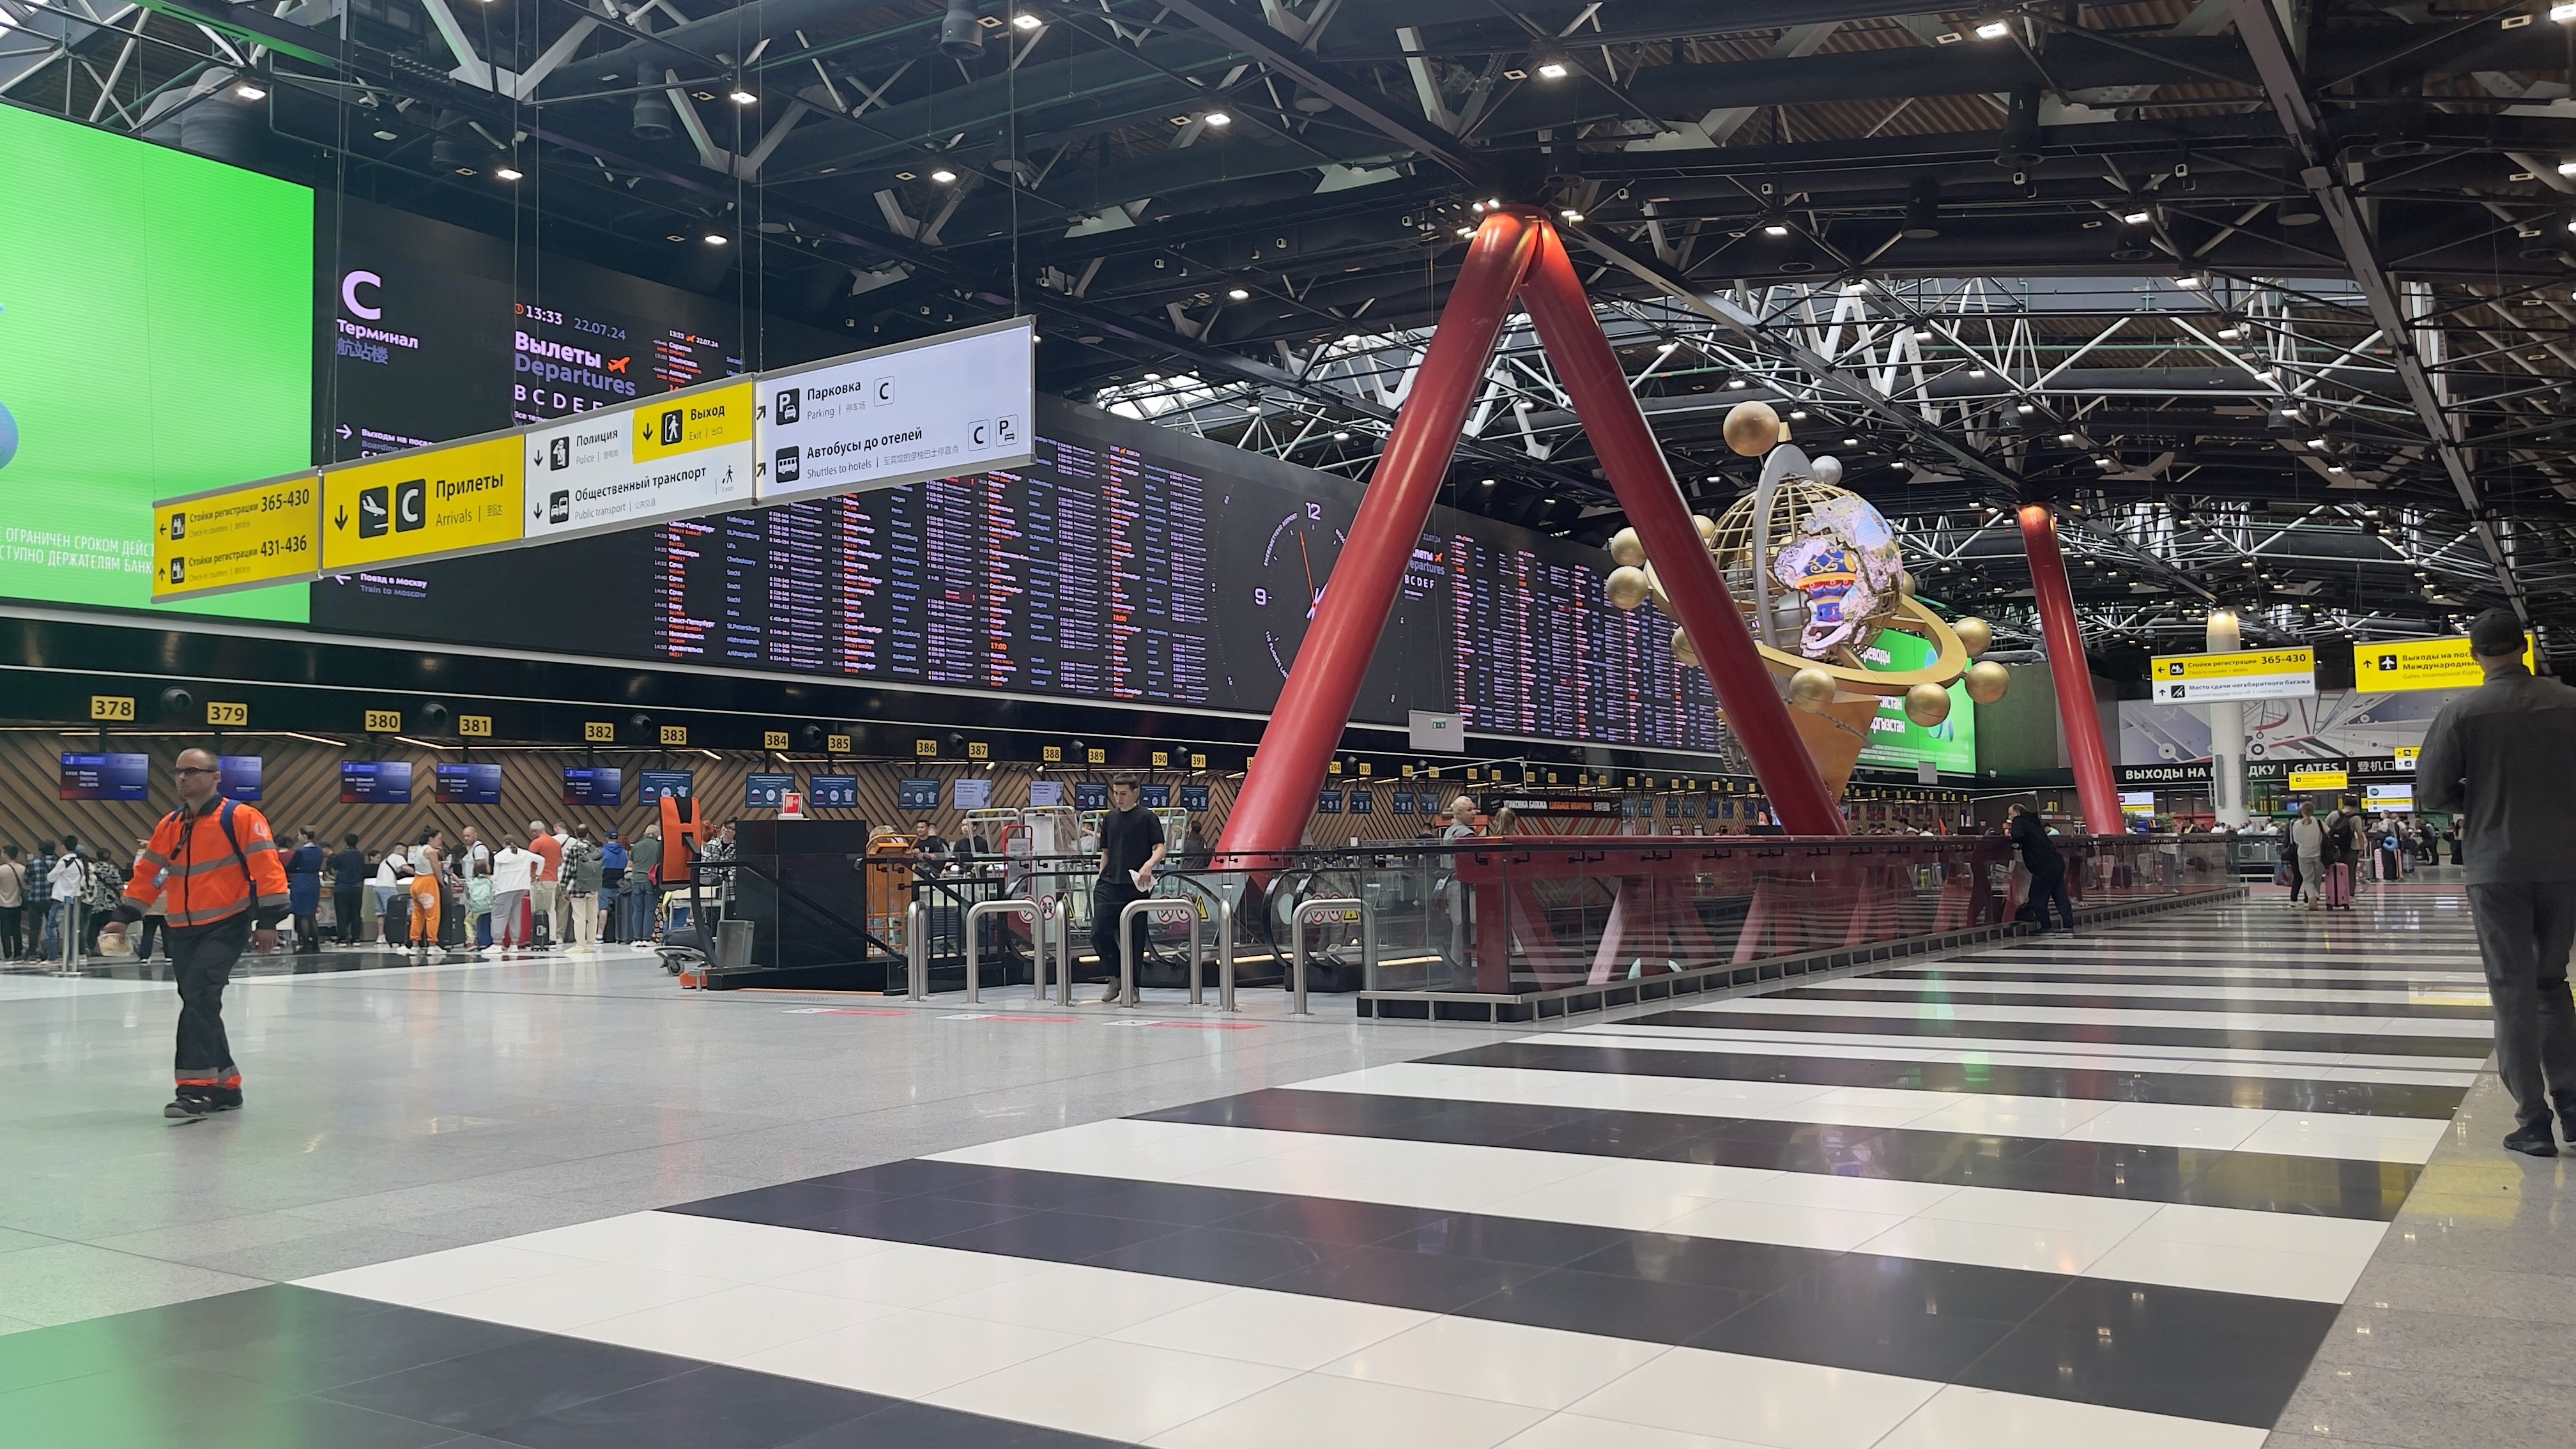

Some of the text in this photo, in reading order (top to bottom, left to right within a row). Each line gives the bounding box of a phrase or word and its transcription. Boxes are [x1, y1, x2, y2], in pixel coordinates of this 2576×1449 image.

[342, 271, 381, 319] C
[526, 305, 626, 341] 13:33 22.07.24
[336, 319, 418, 349] Терминал
[337, 337, 388, 365] 航站楼
[515, 331, 602, 369] Вылеты
[515, 353, 636, 397] Departures
[514, 384, 526, 401] B
[533, 389, 546, 406] C
[553, 392, 567, 409] D
[574, 396, 584, 414] E
[807, 381, 889, 402] Парковка C
[691, 405, 725, 421] Выход
[807, 406, 835, 420] Parking
[361, 429, 395, 441] Выходы
[576, 429, 618, 447] Полиция
[689, 431, 702, 441] Exit
[711, 426, 723, 436] 出口
[807, 440, 861, 460] Автобусы
[864, 438, 878, 452] до
[881, 427, 923, 447] отелей
[974, 425, 984, 445] C
[576, 454, 595, 465] Police
[807, 460, 871, 479] Shuttles to hotels
[436, 474, 503, 501] Прилеты
[575, 466, 707, 502] Общественный транспорт
[190, 489, 309, 523] Стойки регистрации 365-430
[402, 488, 419, 523] C
[576, 503, 626, 521] Public transport
[1305, 502, 1321, 520] 12
[436, 509, 472, 526] Arrivals
[6, 528, 70, 548] ОГРАНИЧЕН
[74, 535, 118, 553] СРОКОМ
[188, 535, 307, 567] Стойки регистрации 431-436
[48, 551, 120, 571] ДЕРЖАТЕЛЯМ
[360, 573, 387, 584] Поезд
[396, 578, 427, 589] Москву
[360, 585, 381, 594] Train
[394, 589, 426, 598] Moscow
[1255, 588, 1266, 606] 9
[2213, 659, 2257, 670] регистрации
[2261, 654, 2306, 665] 365-430
[2232, 680, 2284, 690] негабаритного
[95, 701, 132, 716] 378
[211, 707, 245, 721] 379
[368, 714, 398, 729] 380
[462, 719, 489, 733] 381
[587, 725, 611, 739] 382
[663, 729, 685, 742] 383
[767, 735, 787, 746] 384
[830, 738, 848, 749] 385
[918, 742, 935, 753] 386
[970, 745, 986, 755] 387
[1045, 749, 1059, 759] 388
[1090, 751, 1103, 760] 389
[1154, 755, 1167, 763] 390
[1193, 756, 1205, 765] 391
[2126, 767, 2207, 780] ВЫХОДЫ НА
[2294, 763, 2339, 772] GATES
